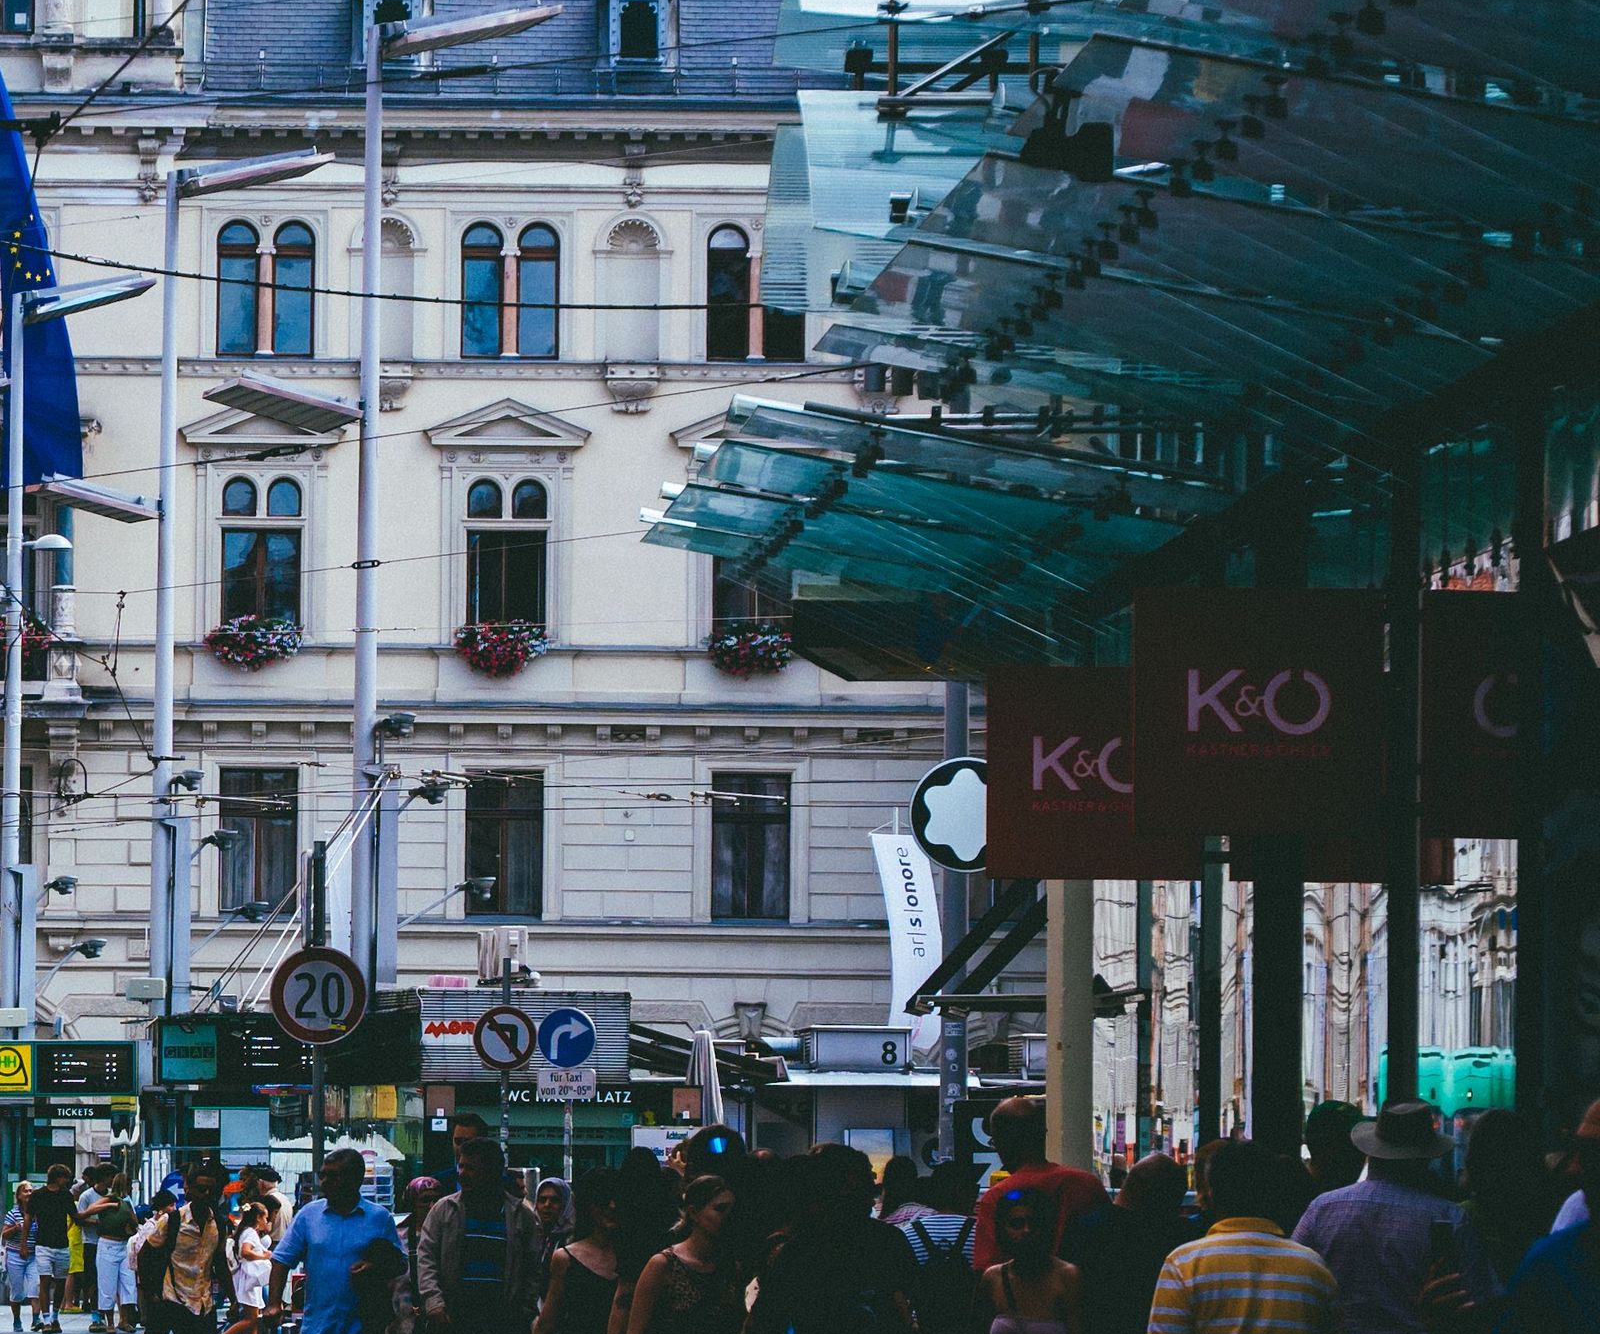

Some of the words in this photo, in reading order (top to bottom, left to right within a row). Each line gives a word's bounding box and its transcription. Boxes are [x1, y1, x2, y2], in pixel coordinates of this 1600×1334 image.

[1187, 668, 1331, 736] K&O
[294, 971, 345, 1019] 20
[164, 1045, 215, 1059] GRAZ
[881, 1040, 898, 1065] 8
[551, 1072, 562, 1083] für
[565, 1073, 583, 1083] Taxi
[540, 1088, 556, 1096] von
[56, 1107, 94, 1117] TICKETS
